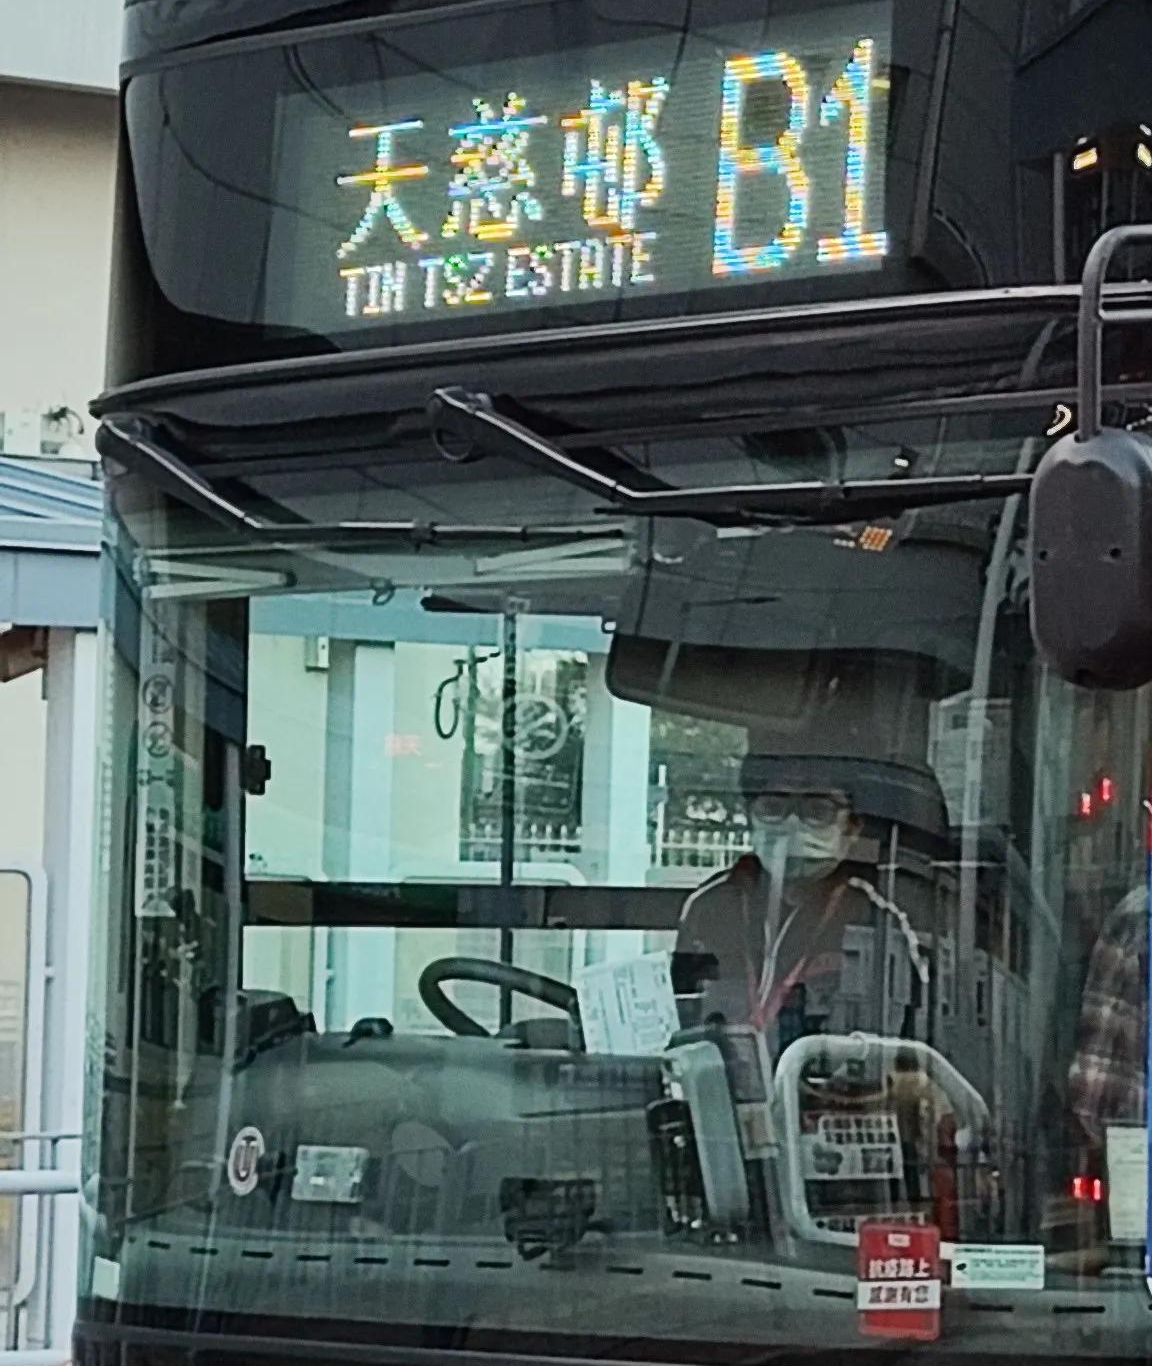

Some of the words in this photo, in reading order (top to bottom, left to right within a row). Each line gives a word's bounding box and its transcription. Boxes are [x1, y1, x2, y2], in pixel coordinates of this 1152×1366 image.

[337, 77, 670, 258] 天慈邨
[713, 38, 888, 274] B1
[340, 262, 406, 315] TIN
[419, 252, 495, 306] TSZ
[505, 231, 657, 298] ESTATE
